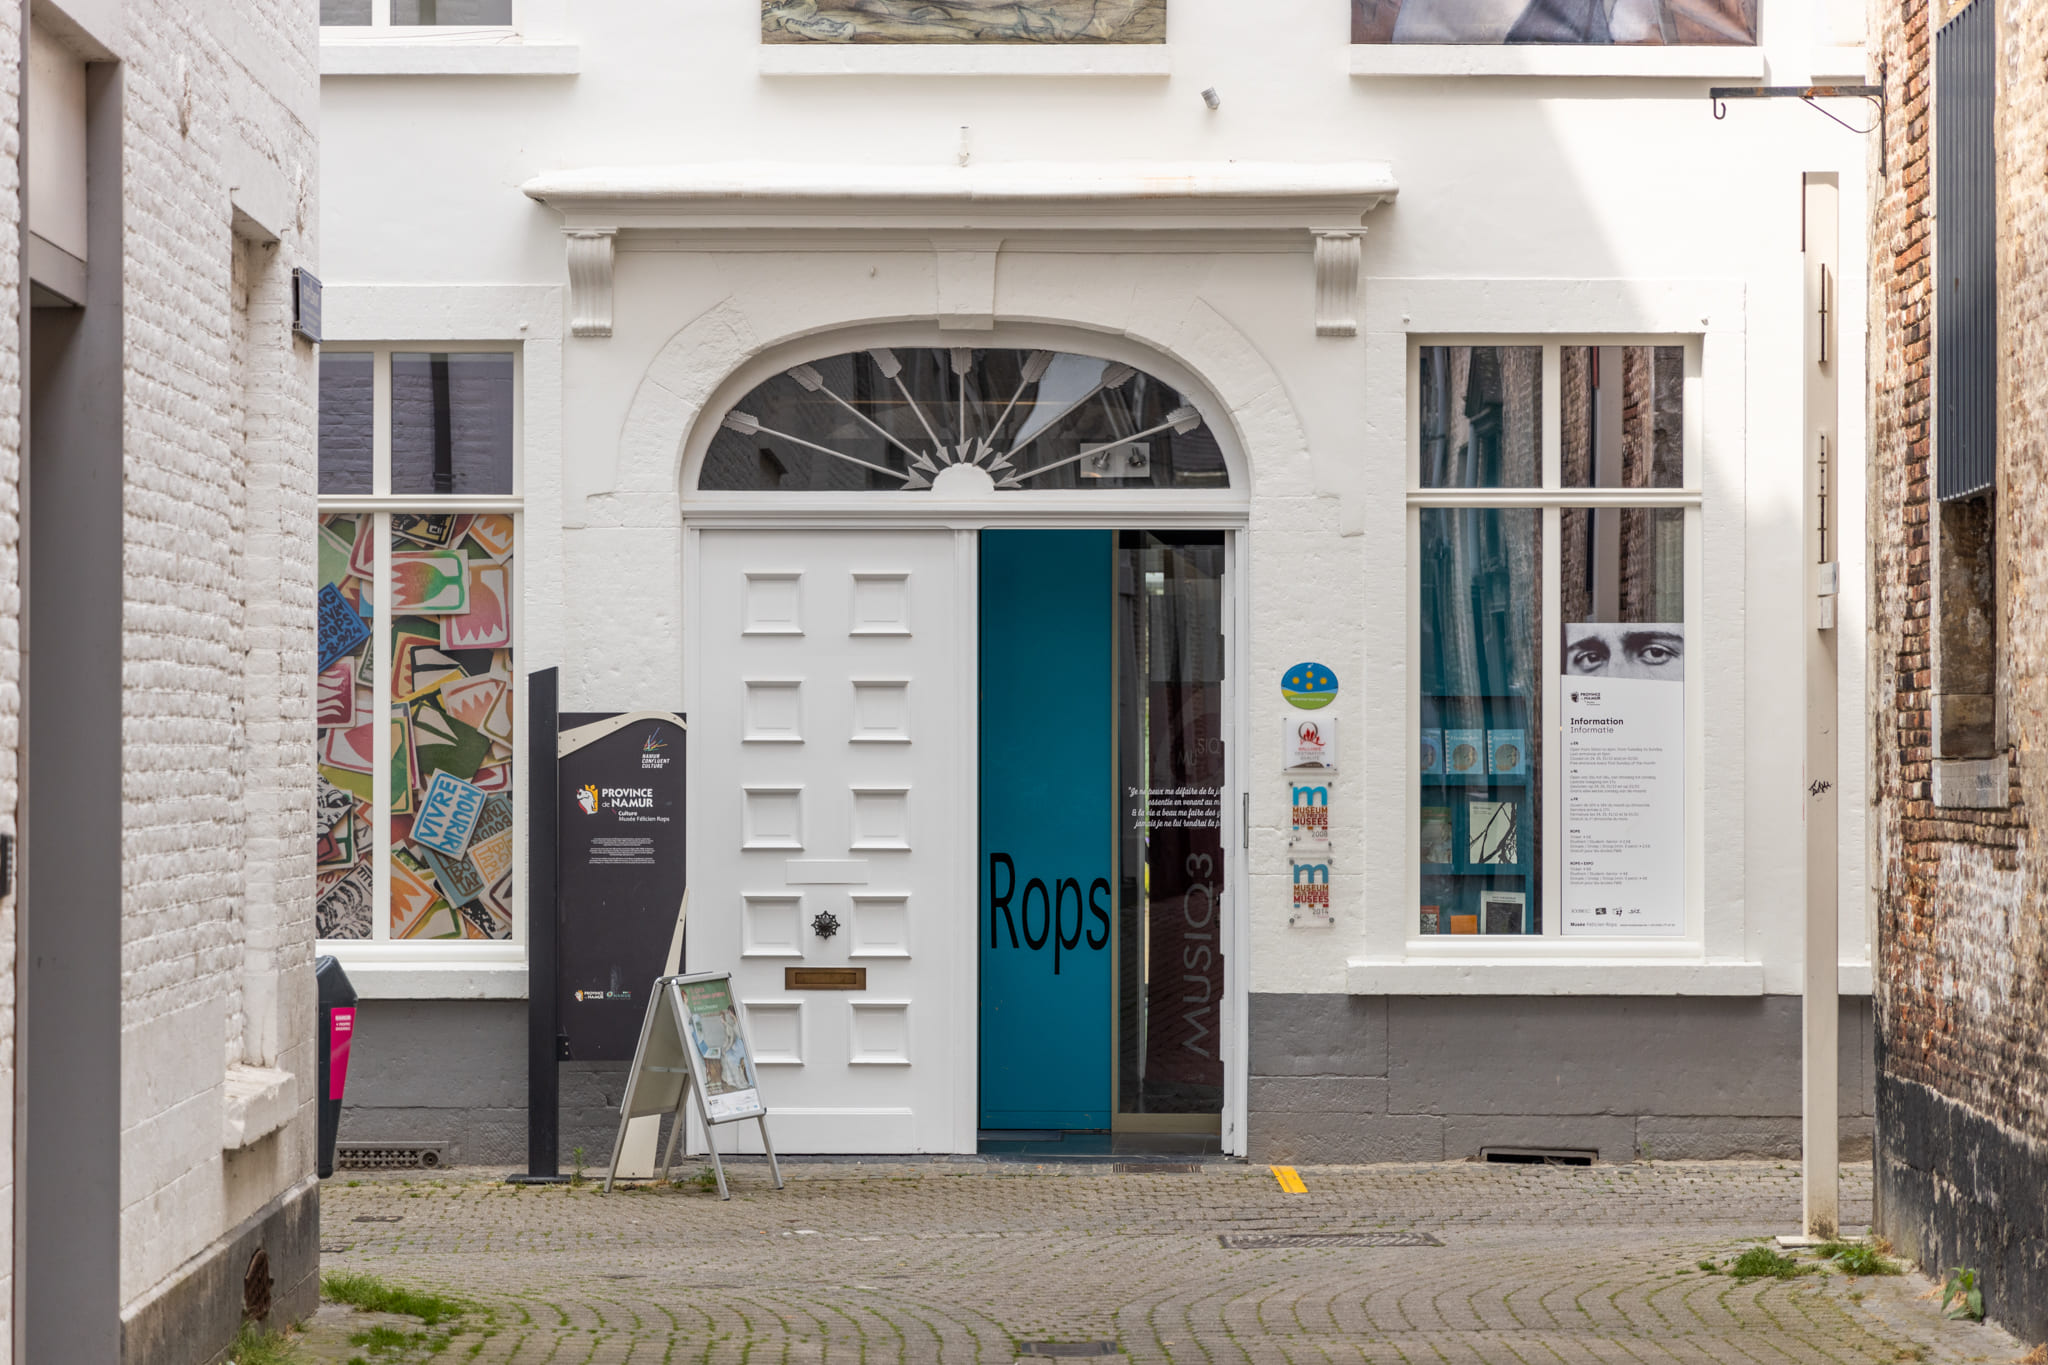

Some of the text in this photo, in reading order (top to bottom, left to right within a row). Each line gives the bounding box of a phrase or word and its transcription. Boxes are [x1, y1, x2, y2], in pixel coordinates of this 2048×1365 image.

[602, 788, 653, 797] PROVINCE
[611, 798, 653, 807] NAMUR
[1292, 786, 1328, 806] m
[419, 780, 458, 838] VIVRE
[1188, 808, 1204, 819] faire
[1293, 864, 1328, 884] m
[990, 852, 1111, 975] Rops
[1181, 852, 1213, 1057] MUSIQ3
